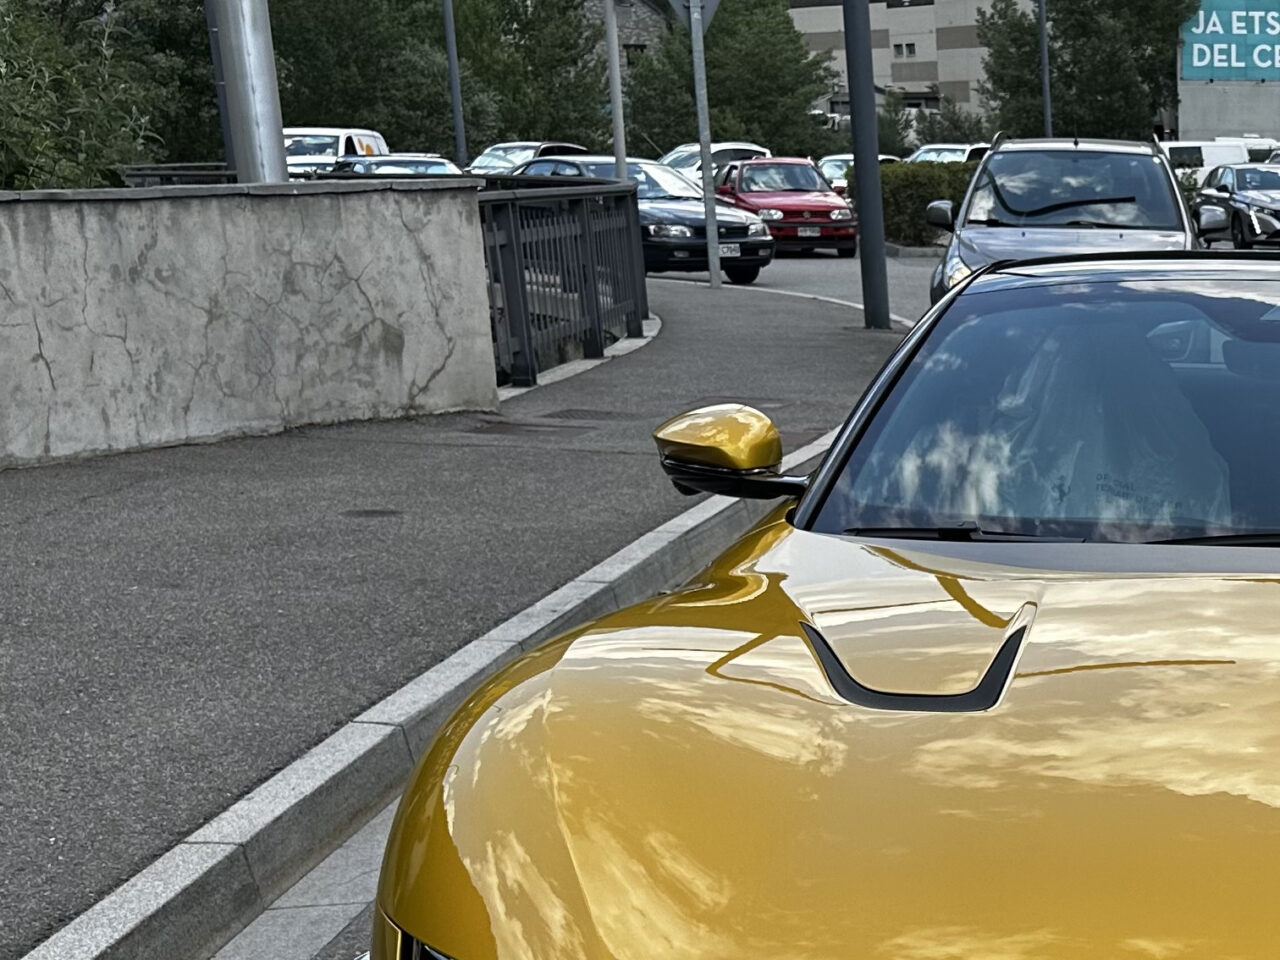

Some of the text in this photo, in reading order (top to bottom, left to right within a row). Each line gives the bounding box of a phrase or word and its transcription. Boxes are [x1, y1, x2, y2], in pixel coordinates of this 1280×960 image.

[1191, 10, 1224, 34] JA
[1231, 10, 1280, 35] ETS
[1192, 43, 1246, 68] DEL
